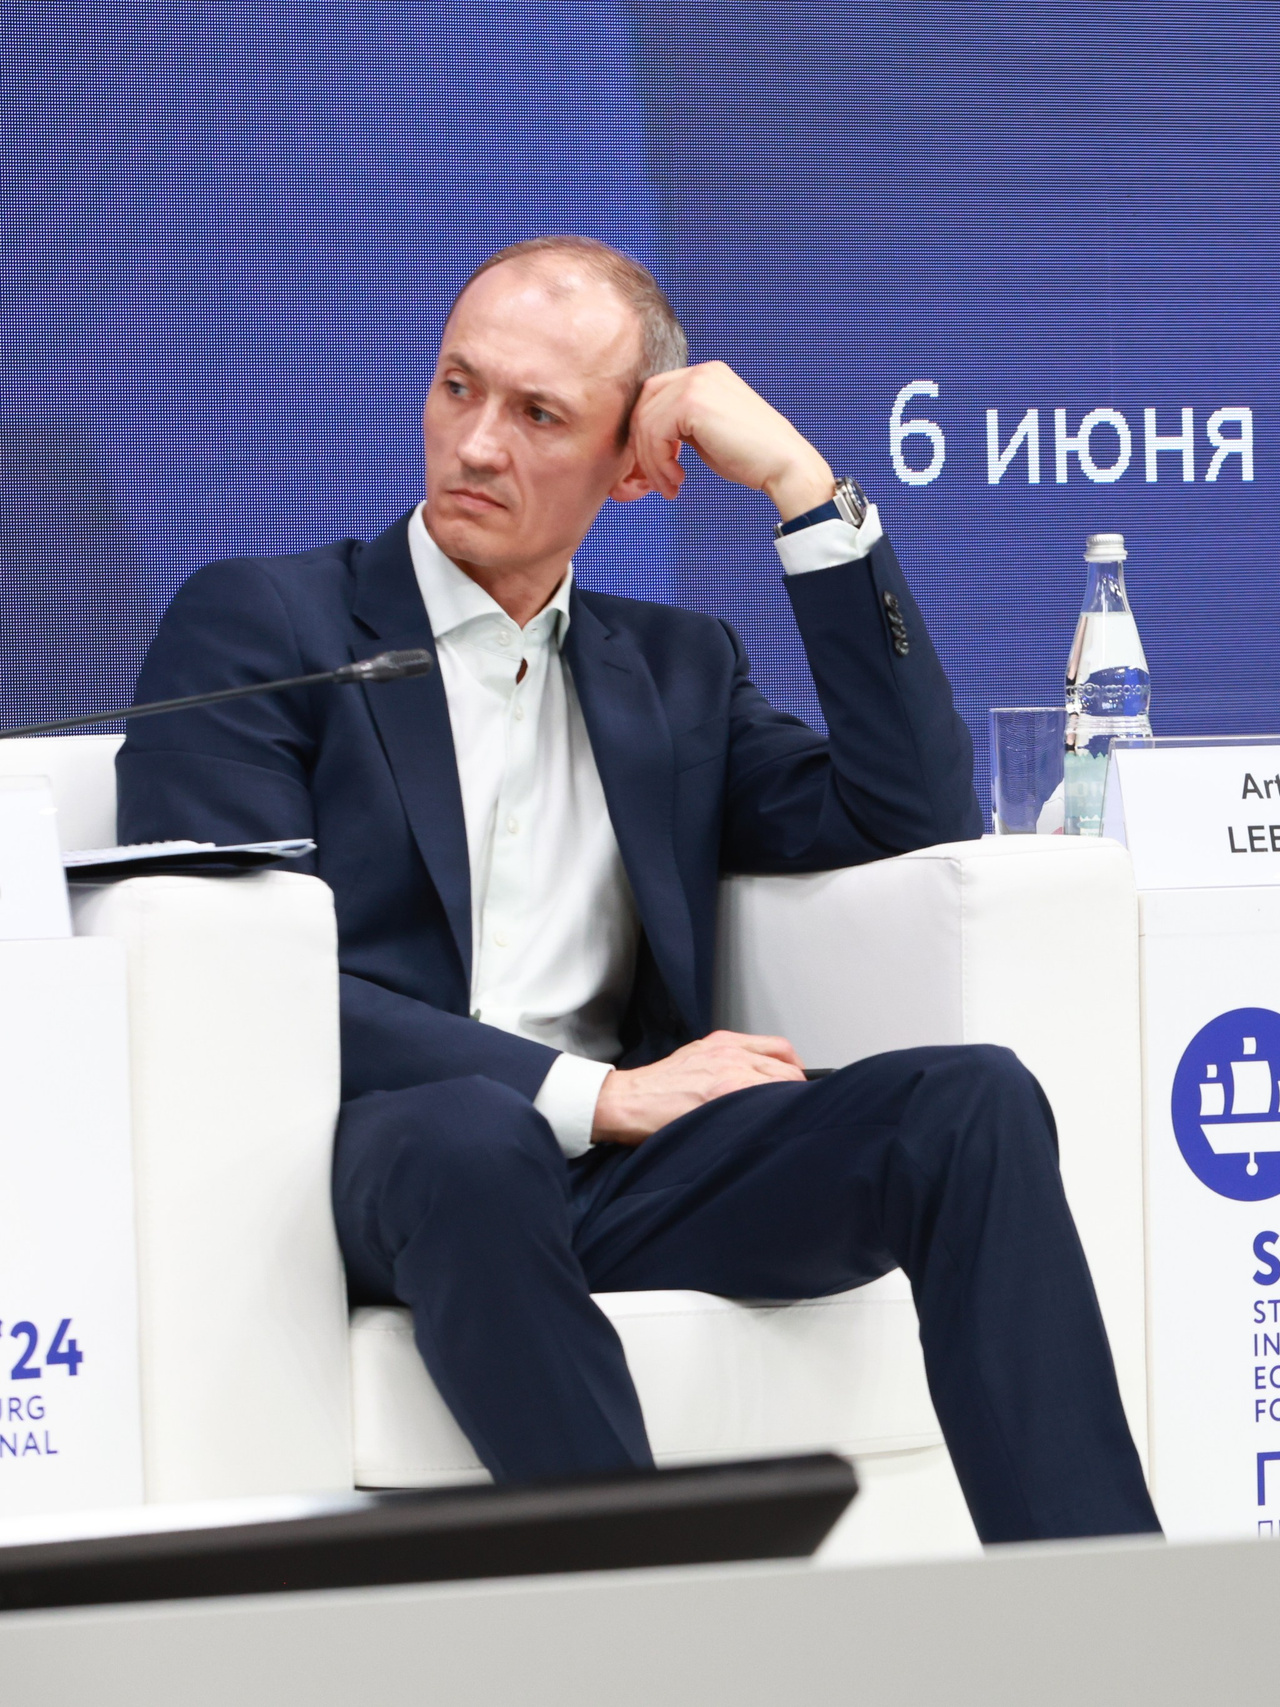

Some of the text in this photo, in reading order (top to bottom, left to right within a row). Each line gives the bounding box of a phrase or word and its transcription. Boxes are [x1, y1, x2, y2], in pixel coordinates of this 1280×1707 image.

[889, 380, 1254, 486] 6 июня
[0, 1318, 83, 1381] 24
[0, 1394, 45, 1421] RG
